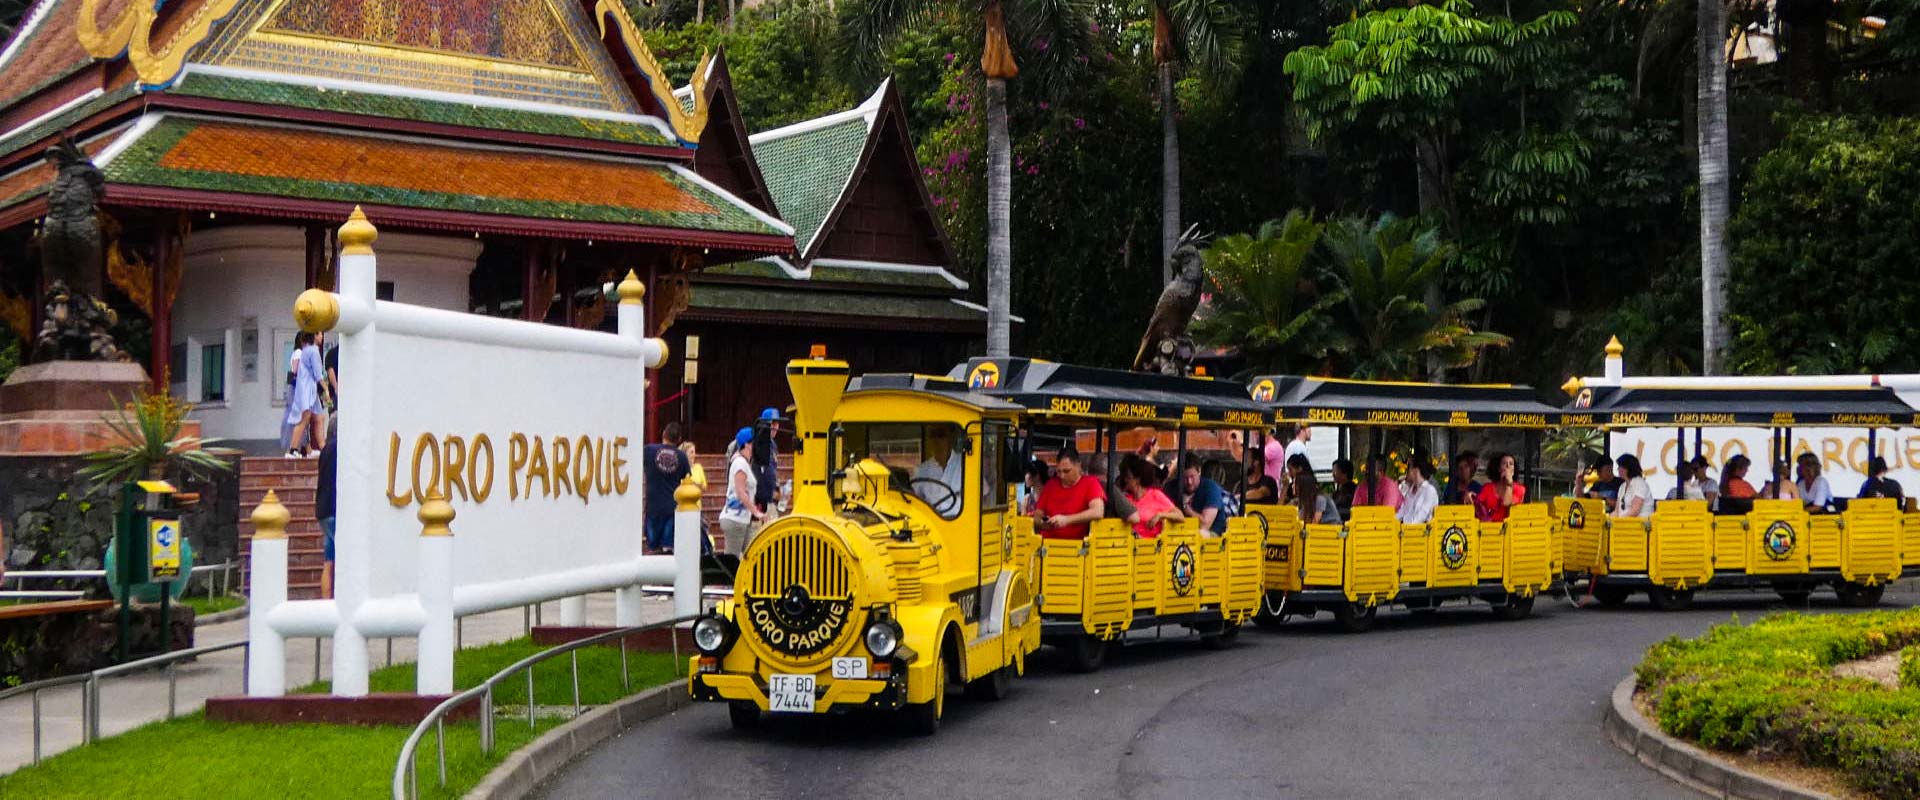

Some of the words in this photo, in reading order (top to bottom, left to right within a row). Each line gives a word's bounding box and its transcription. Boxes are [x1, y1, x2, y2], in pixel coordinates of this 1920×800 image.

[1050, 398, 1091, 414] SHOW
[1110, 402, 1129, 418] LORO
[1308, 408, 1346, 421] SHOW
[1368, 411, 1389, 422] LORO
[1390, 411, 1420, 423] PARQUE
[1499, 414, 1518, 425] LORO
[1612, 413, 1648, 424] SHOW
[1674, 413, 1699, 424] LORO
[1700, 413, 1736, 424] PARQUE
[1832, 413, 1856, 424] LORO
[386, 431, 494, 508] LORO
[508, 432, 629, 505] PARQUE
[752, 600, 784, 645] LORO
[789, 602, 844, 650] PARQUE
[775, 693, 809, 710] 7444
